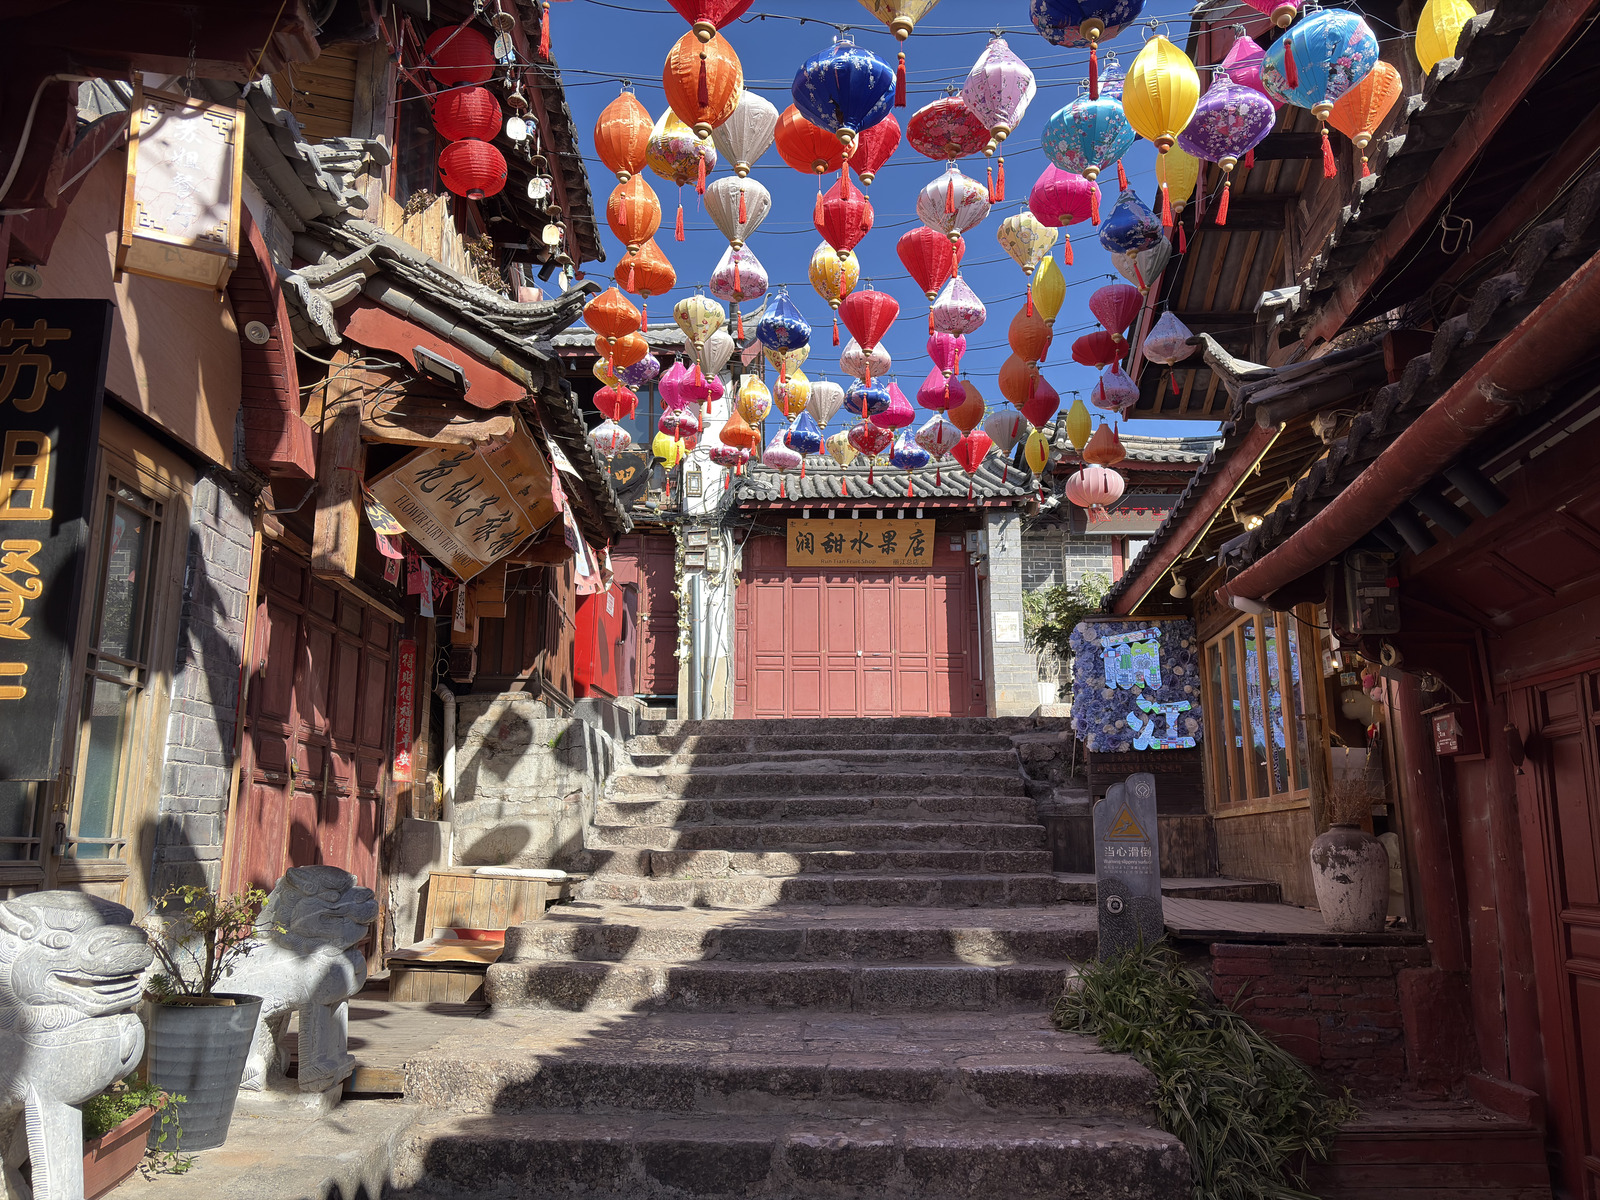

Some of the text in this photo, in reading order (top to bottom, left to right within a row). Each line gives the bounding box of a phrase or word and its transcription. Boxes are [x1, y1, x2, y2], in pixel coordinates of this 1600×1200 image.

[394, 494, 426, 529] FLOWER
[420, 518, 443, 541] FAIRY
[414, 451, 524, 557] 花仙子旅拍
[795, 529, 926, 557] 润甜水果店
[1104, 846, 1152, 857] 当心滑倒
